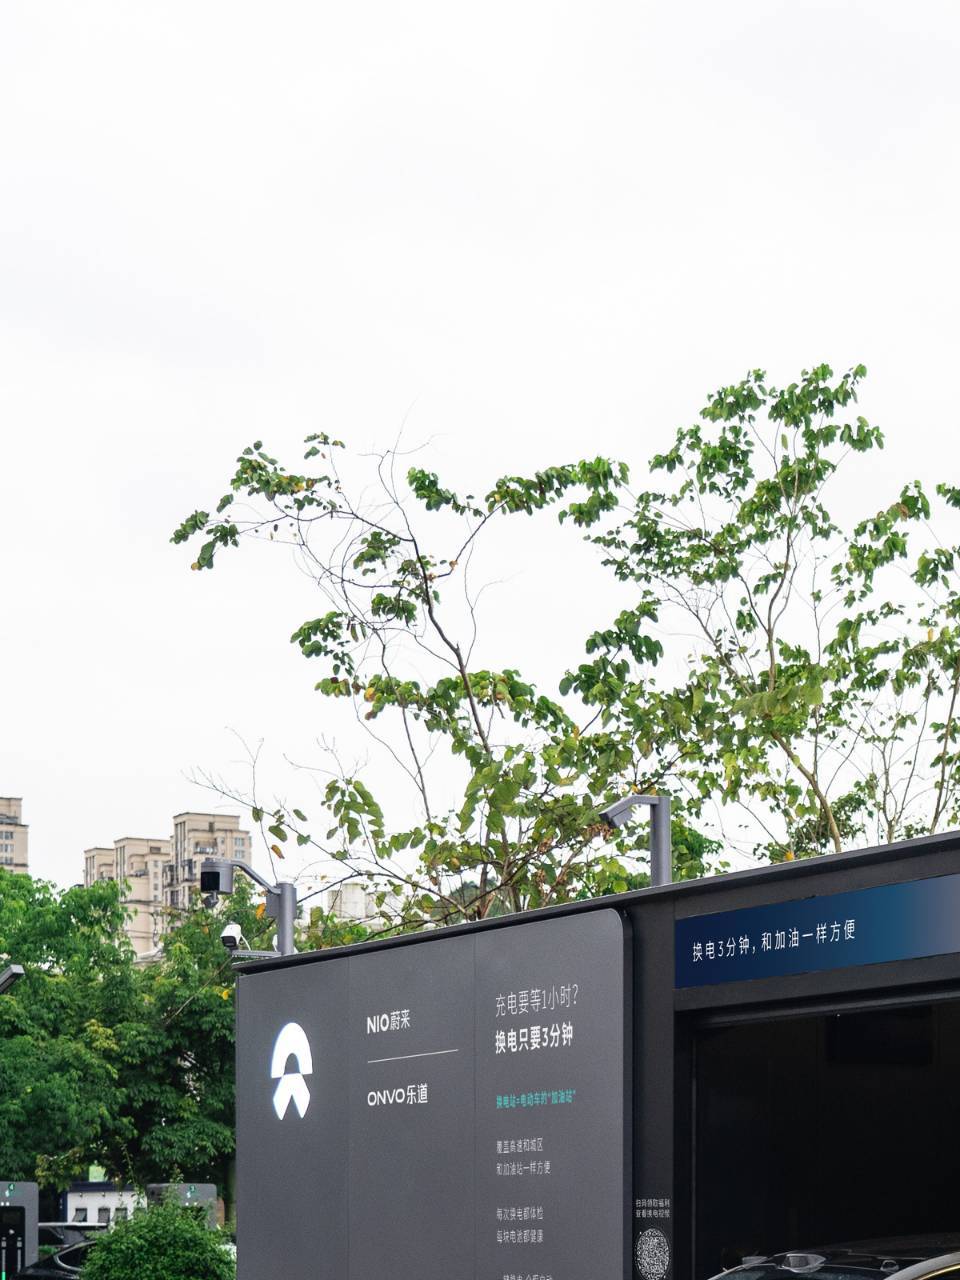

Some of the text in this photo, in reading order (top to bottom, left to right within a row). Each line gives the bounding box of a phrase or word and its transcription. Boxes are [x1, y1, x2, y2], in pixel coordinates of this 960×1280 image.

[495, 1021, 574, 1055] 换电只要3分钟
[496, 1160, 551, 1176] 和加油站一样方便
